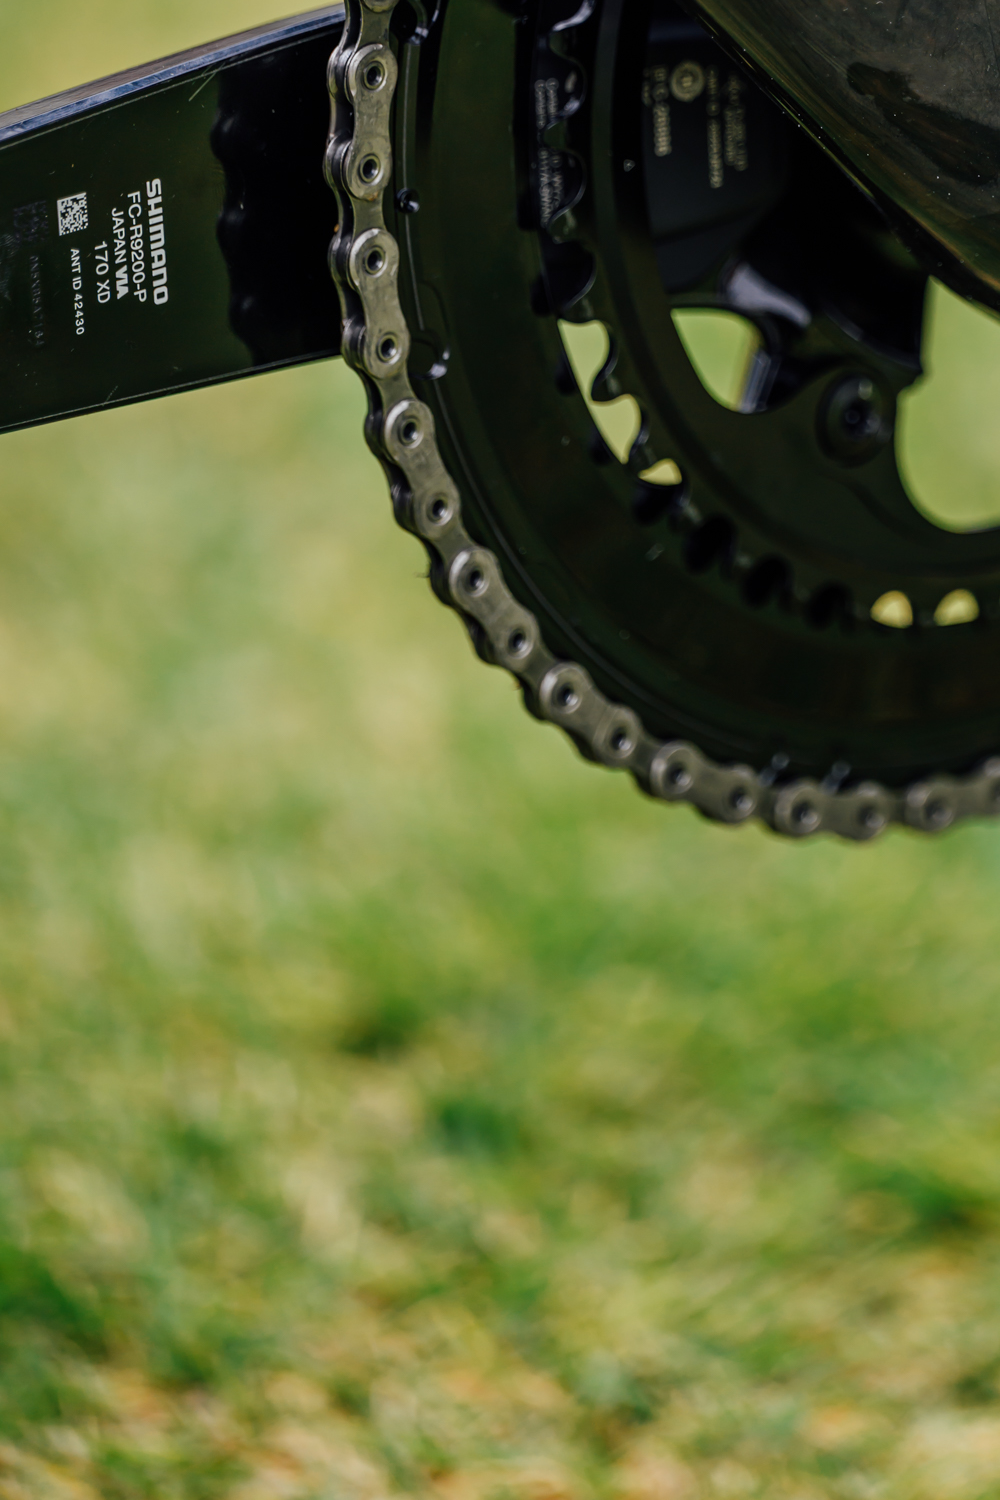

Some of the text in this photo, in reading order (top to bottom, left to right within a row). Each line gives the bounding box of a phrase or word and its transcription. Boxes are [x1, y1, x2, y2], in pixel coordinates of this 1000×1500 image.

[94, 241, 111, 304] 170 XD
[111, 207, 127, 264] JAPAN
[127, 191, 148, 303] FC-R9200-P
[146, 178, 169, 305] SHIMANO
[70, 248, 85, 336] ANT ID 42430
